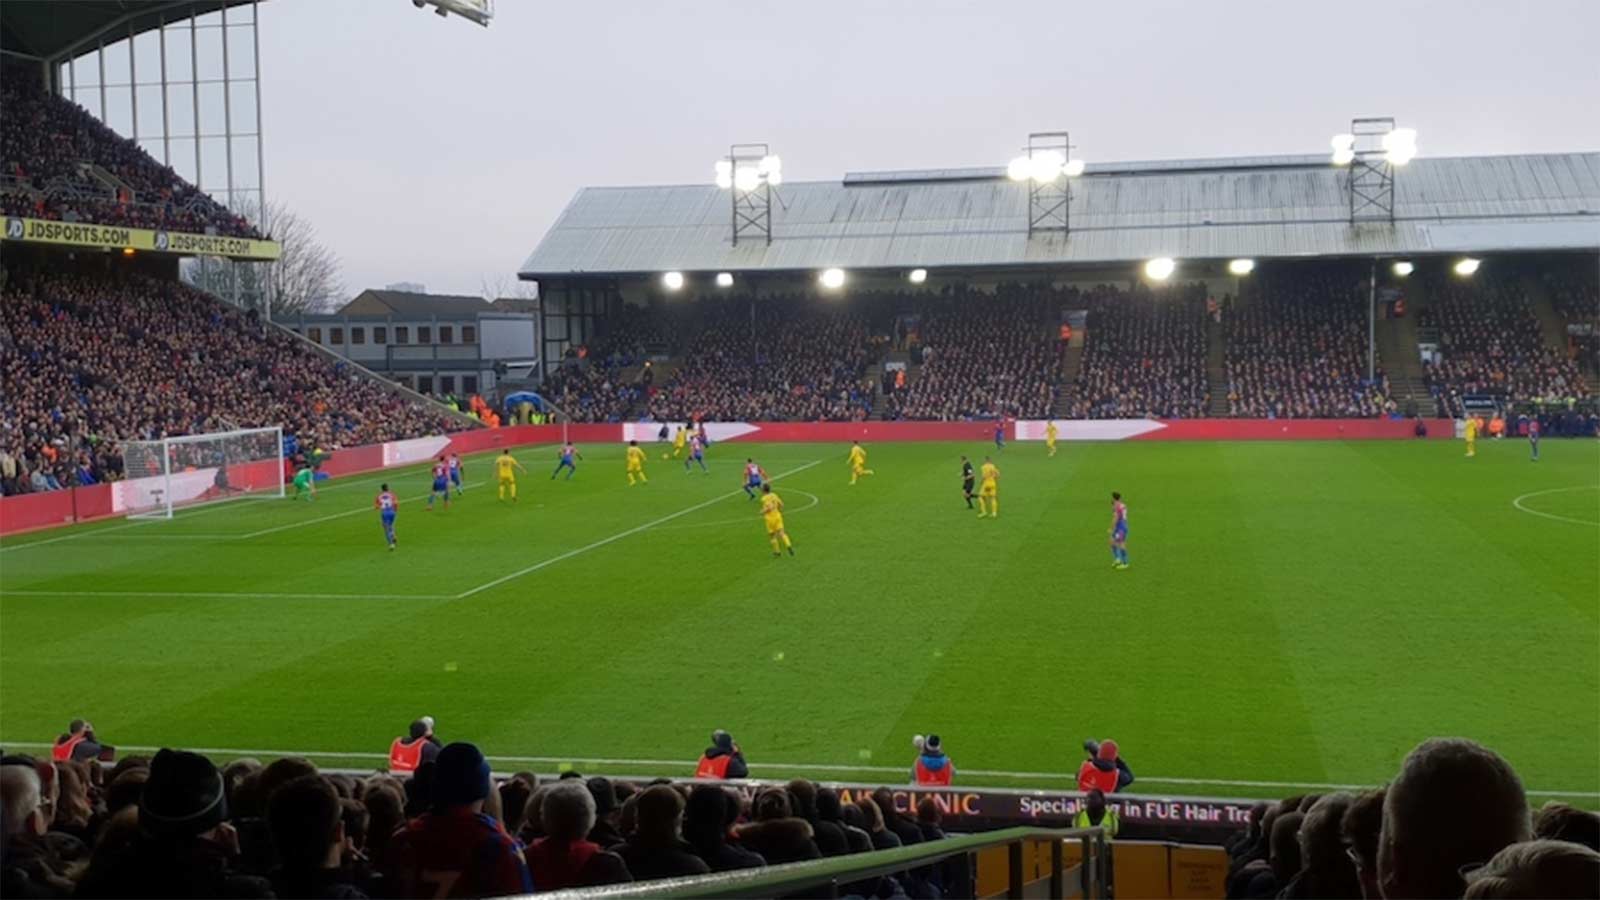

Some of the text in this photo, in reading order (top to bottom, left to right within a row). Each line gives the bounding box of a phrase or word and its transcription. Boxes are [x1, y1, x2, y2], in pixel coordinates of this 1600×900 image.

[27, 222, 131, 245] JDSPORTS.COM
[171, 234, 251, 255] JDSPORTS.COM
[893, 791, 981, 815] CLNIC
[1125, 800, 1141, 817] in
[1146, 803, 1181, 820] FUE
[1184, 804, 1222, 821] Hair
